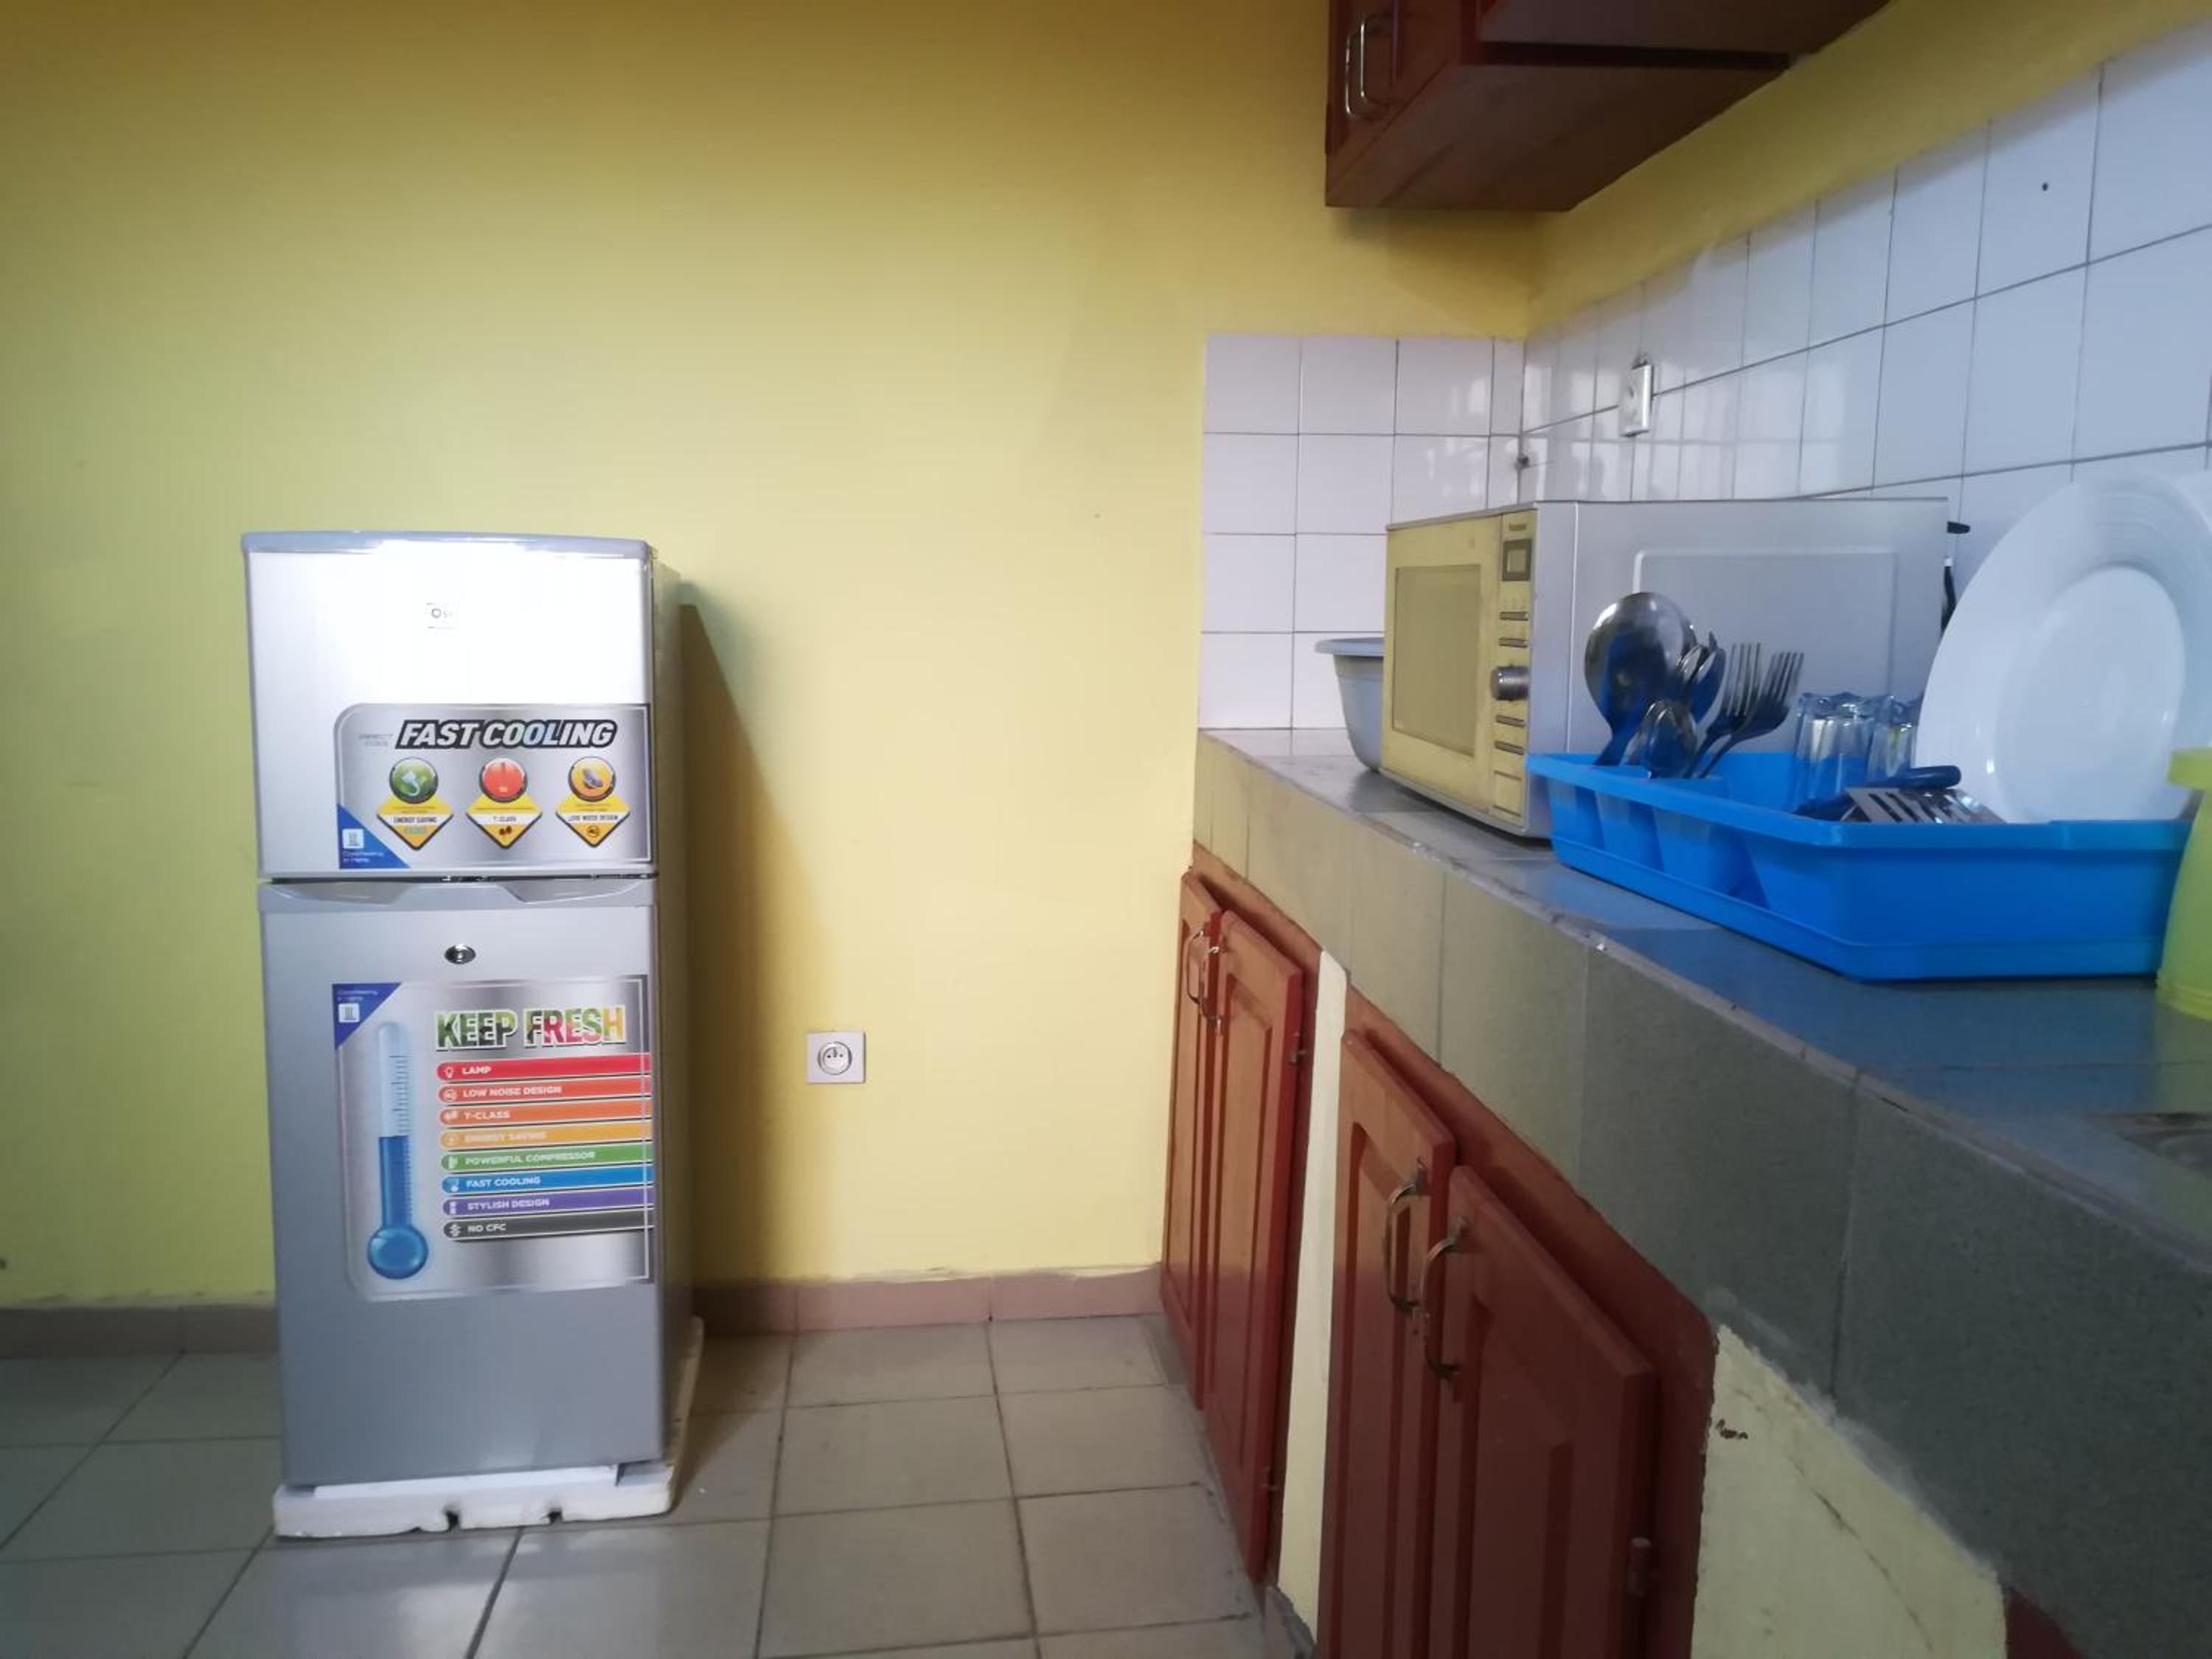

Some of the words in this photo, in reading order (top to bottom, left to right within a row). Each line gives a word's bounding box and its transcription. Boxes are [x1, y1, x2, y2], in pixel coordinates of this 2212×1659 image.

[396, 720, 484, 749] FAST
[481, 720, 618, 749] COOLING
[437, 1009, 518, 1051] KEEP
[523, 1004, 625, 1048] FRESH
[462, 1065, 492, 1075] LAMP
[462, 1089, 487, 1098] LOW
[489, 1088, 521, 1096] NOISE
[523, 1085, 563, 1096] DESIGN
[463, 1110, 510, 1120] T-CLASS
[465, 1155, 524, 1166] POWERFUL
[525, 1151, 596, 1163] COMPRESSOR
[466, 1180, 492, 1189] FAST
[495, 1176, 541, 1186] COOLING
[467, 1200, 509, 1211] STYLISH
[511, 1197, 551, 1208] DESIGN
[467, 1225, 484, 1233] NO
[486, 1223, 507, 1233] CFC
